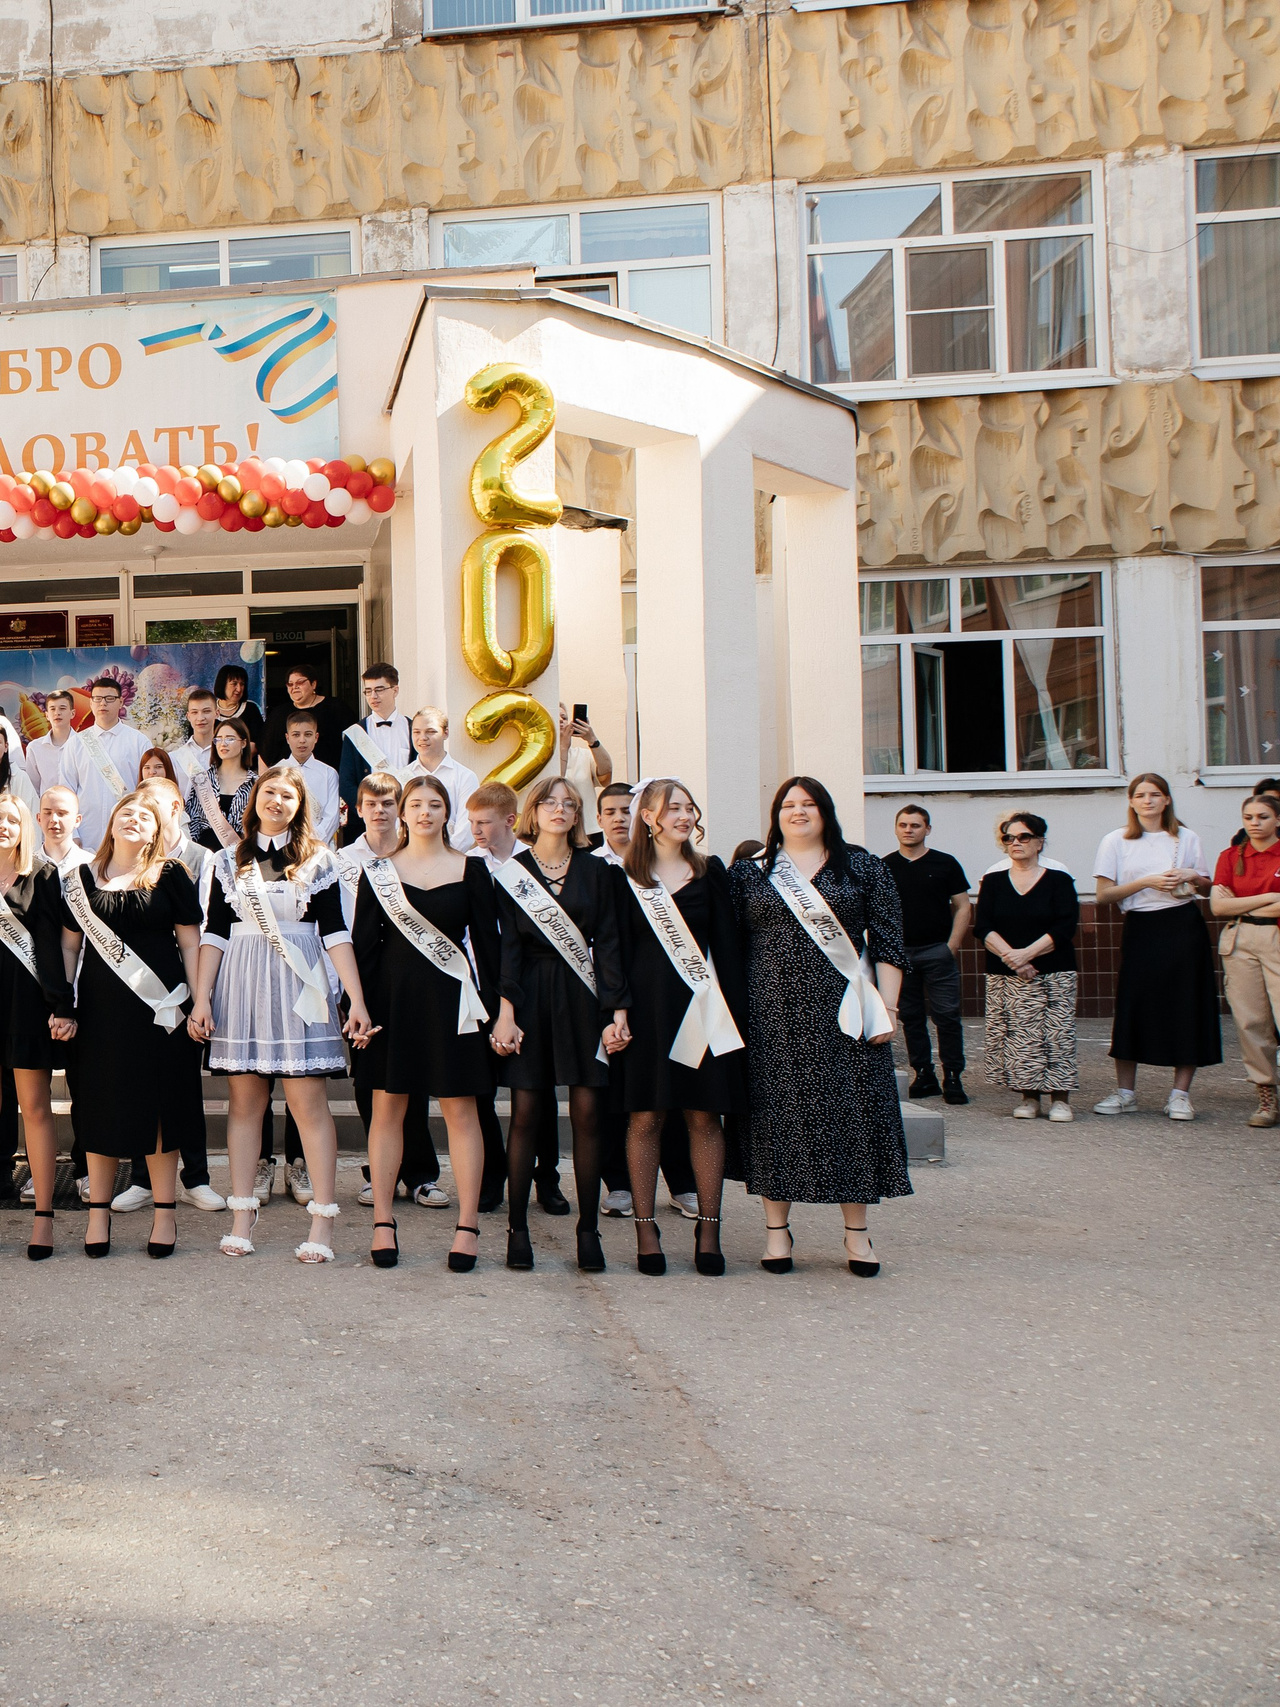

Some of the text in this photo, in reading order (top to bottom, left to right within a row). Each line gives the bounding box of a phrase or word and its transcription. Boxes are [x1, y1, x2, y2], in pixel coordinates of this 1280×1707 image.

[275, 631, 303, 641] ВХОД
[373, 873, 428, 945] Выпускник
[426, 936, 458, 962] 2025
[527, 897, 591, 973] Выпускник
[636, 886, 711, 983] Выпускник 2025
[811, 915, 843, 941] 2025
